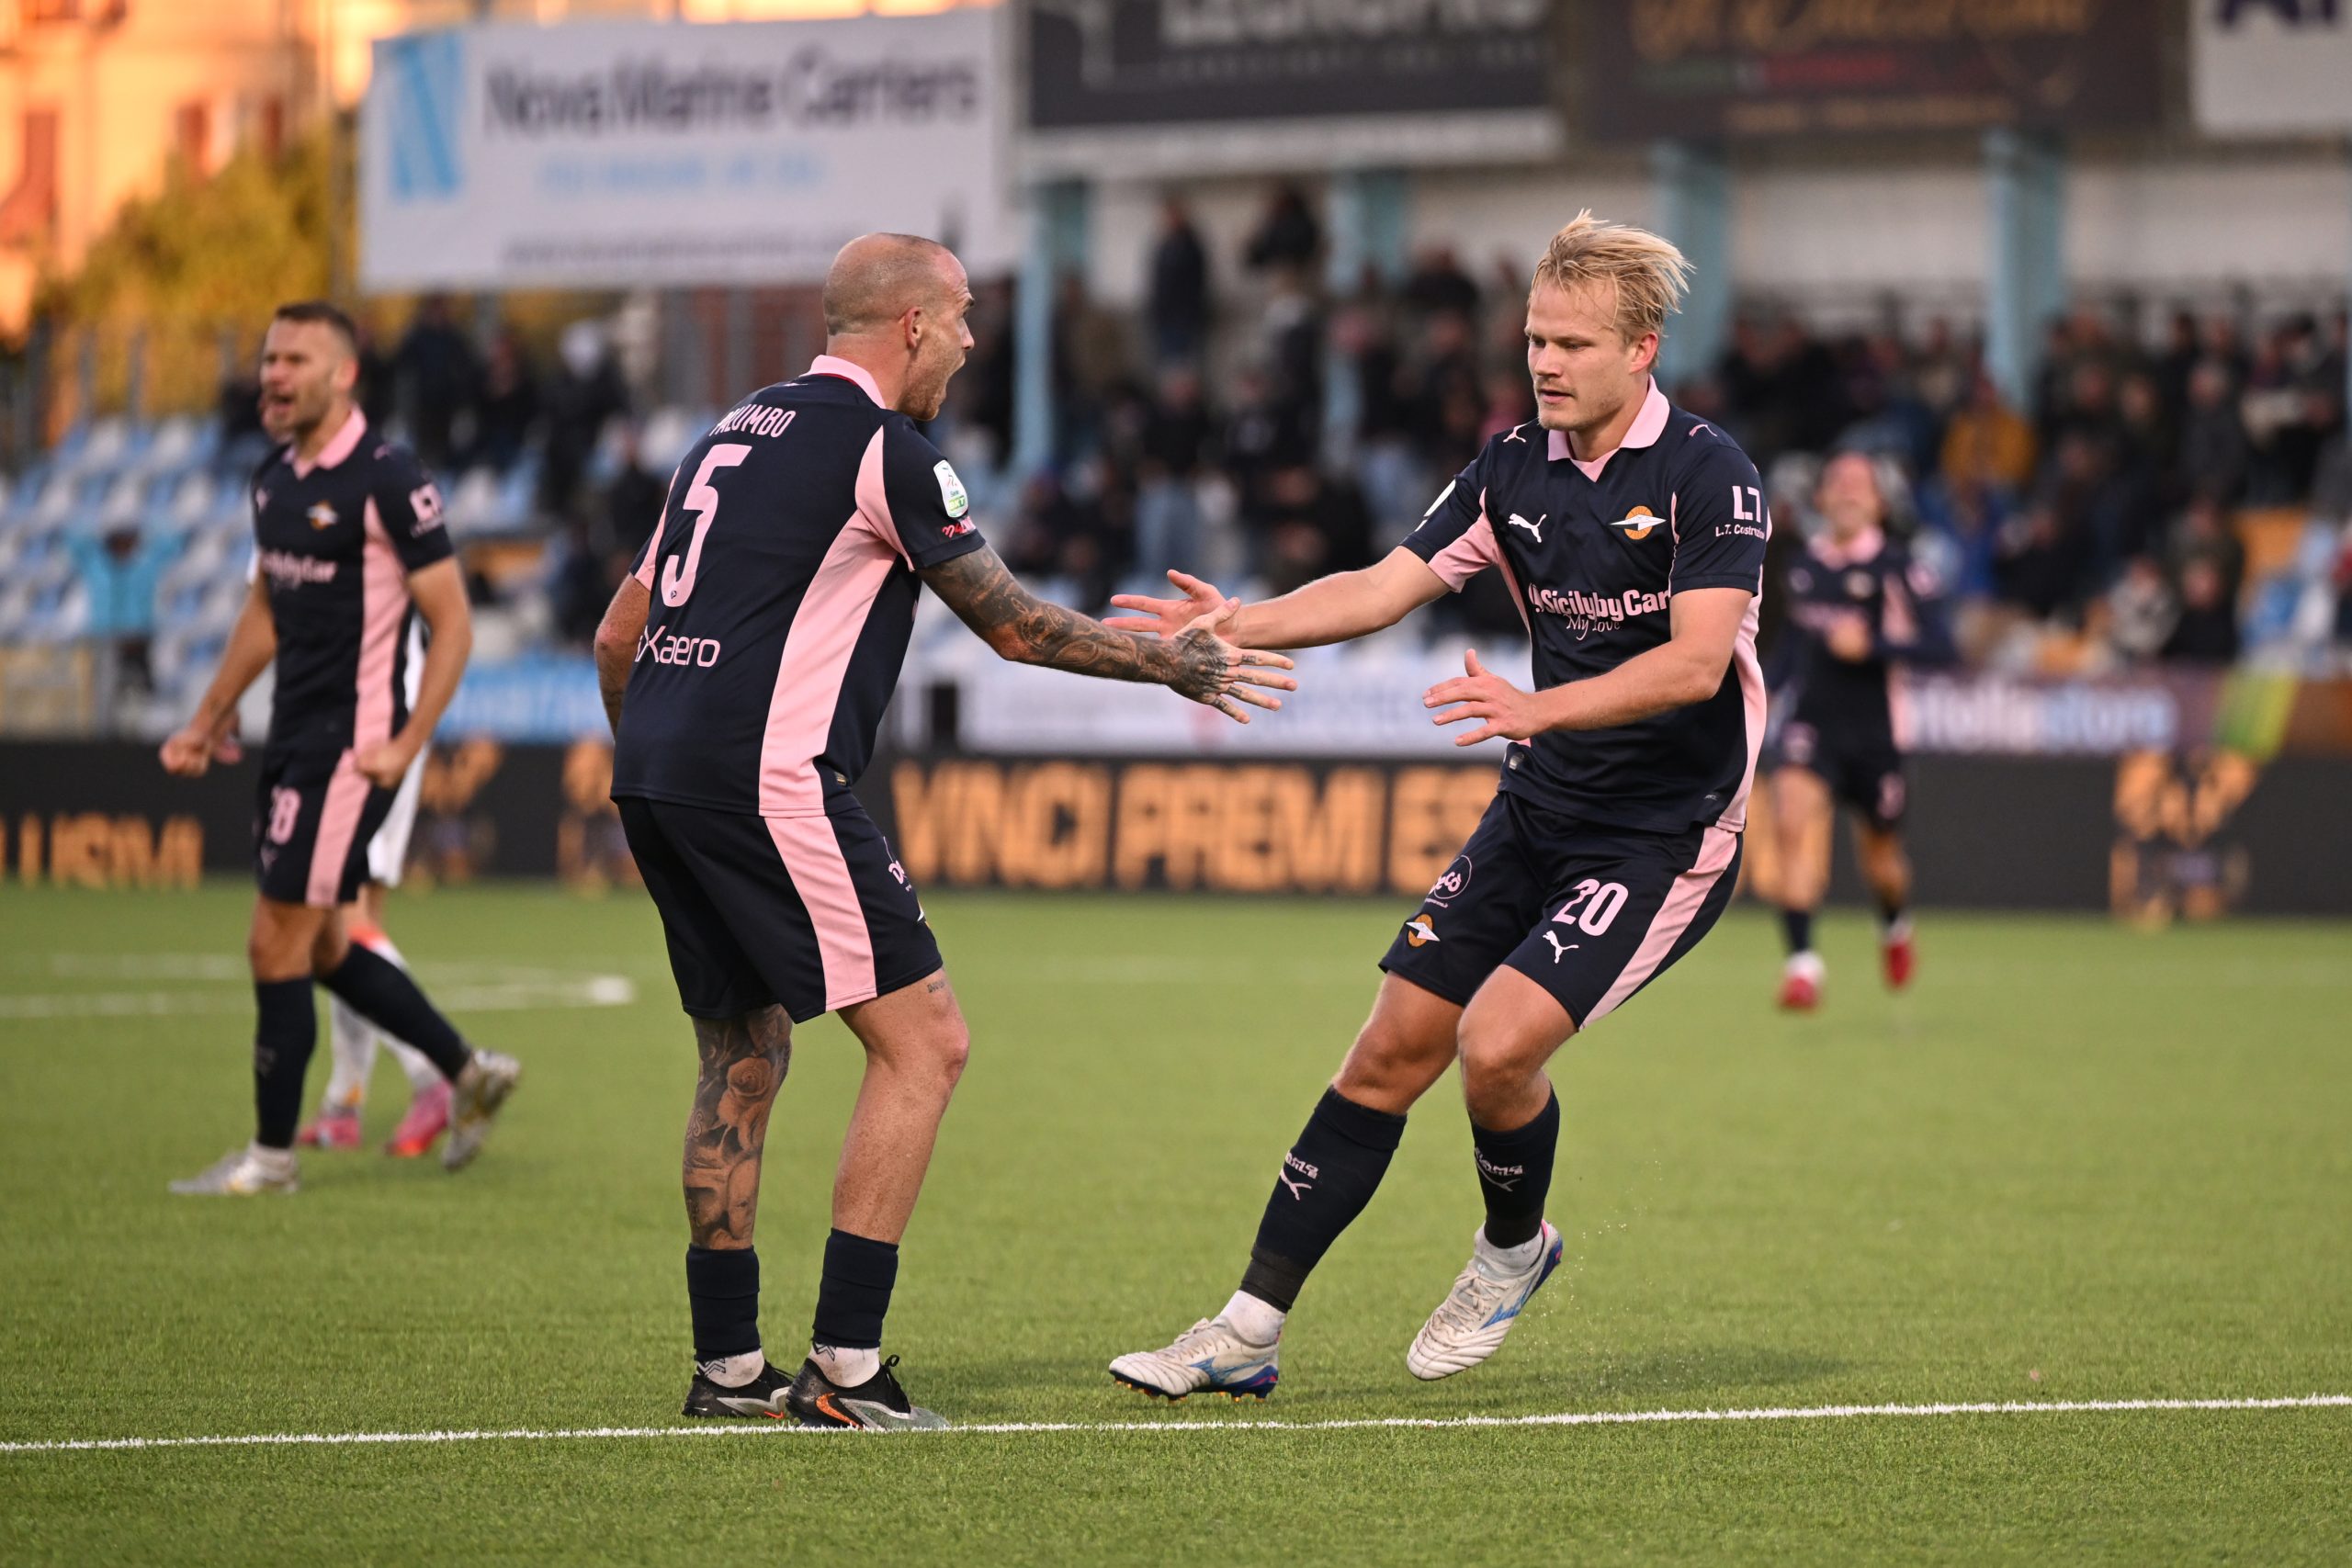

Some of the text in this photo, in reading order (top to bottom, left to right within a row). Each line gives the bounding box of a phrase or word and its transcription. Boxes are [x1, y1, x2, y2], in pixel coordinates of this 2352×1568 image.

[661, 443, 752, 607] 5
[1564, 614, 1589, 641] My
[891, 760, 1111, 888] VINCI
[1114, 761, 1380, 891] PREMI
[1551, 878, 1629, 936] 20
